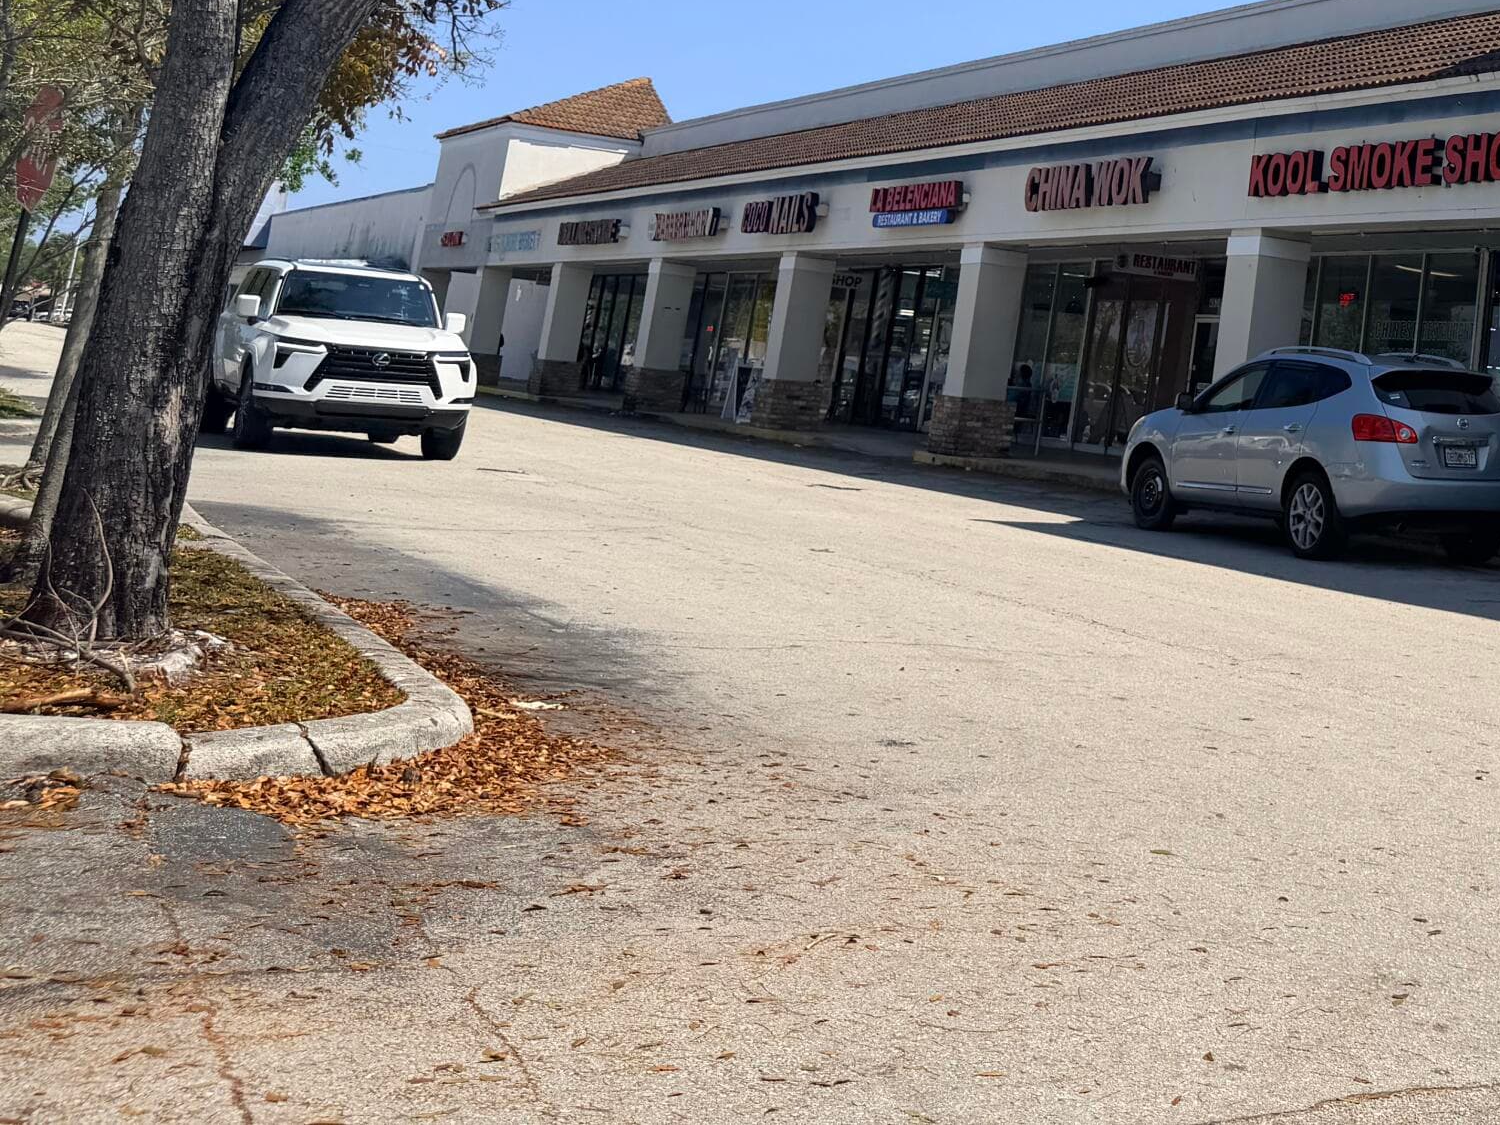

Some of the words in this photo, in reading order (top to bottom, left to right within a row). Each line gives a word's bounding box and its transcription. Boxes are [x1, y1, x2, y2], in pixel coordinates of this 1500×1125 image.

[1025, 163, 1089, 212] CHINA
[1091, 157, 1149, 206] WOK
[1248, 150, 1326, 197] KOOL
[1328, 138, 1440, 191] SMOKE
[741, 201, 769, 233] COCO
[769, 192, 815, 234] NAILS
[870, 188, 883, 212] LA
[885, 180, 957, 211] BELENCIANA
[877, 213, 911, 225] RESTAURANT
[912, 213, 918, 224] &
[918, 210, 942, 224] BAKERY
[1133, 253, 1196, 275] RESTAURANT
